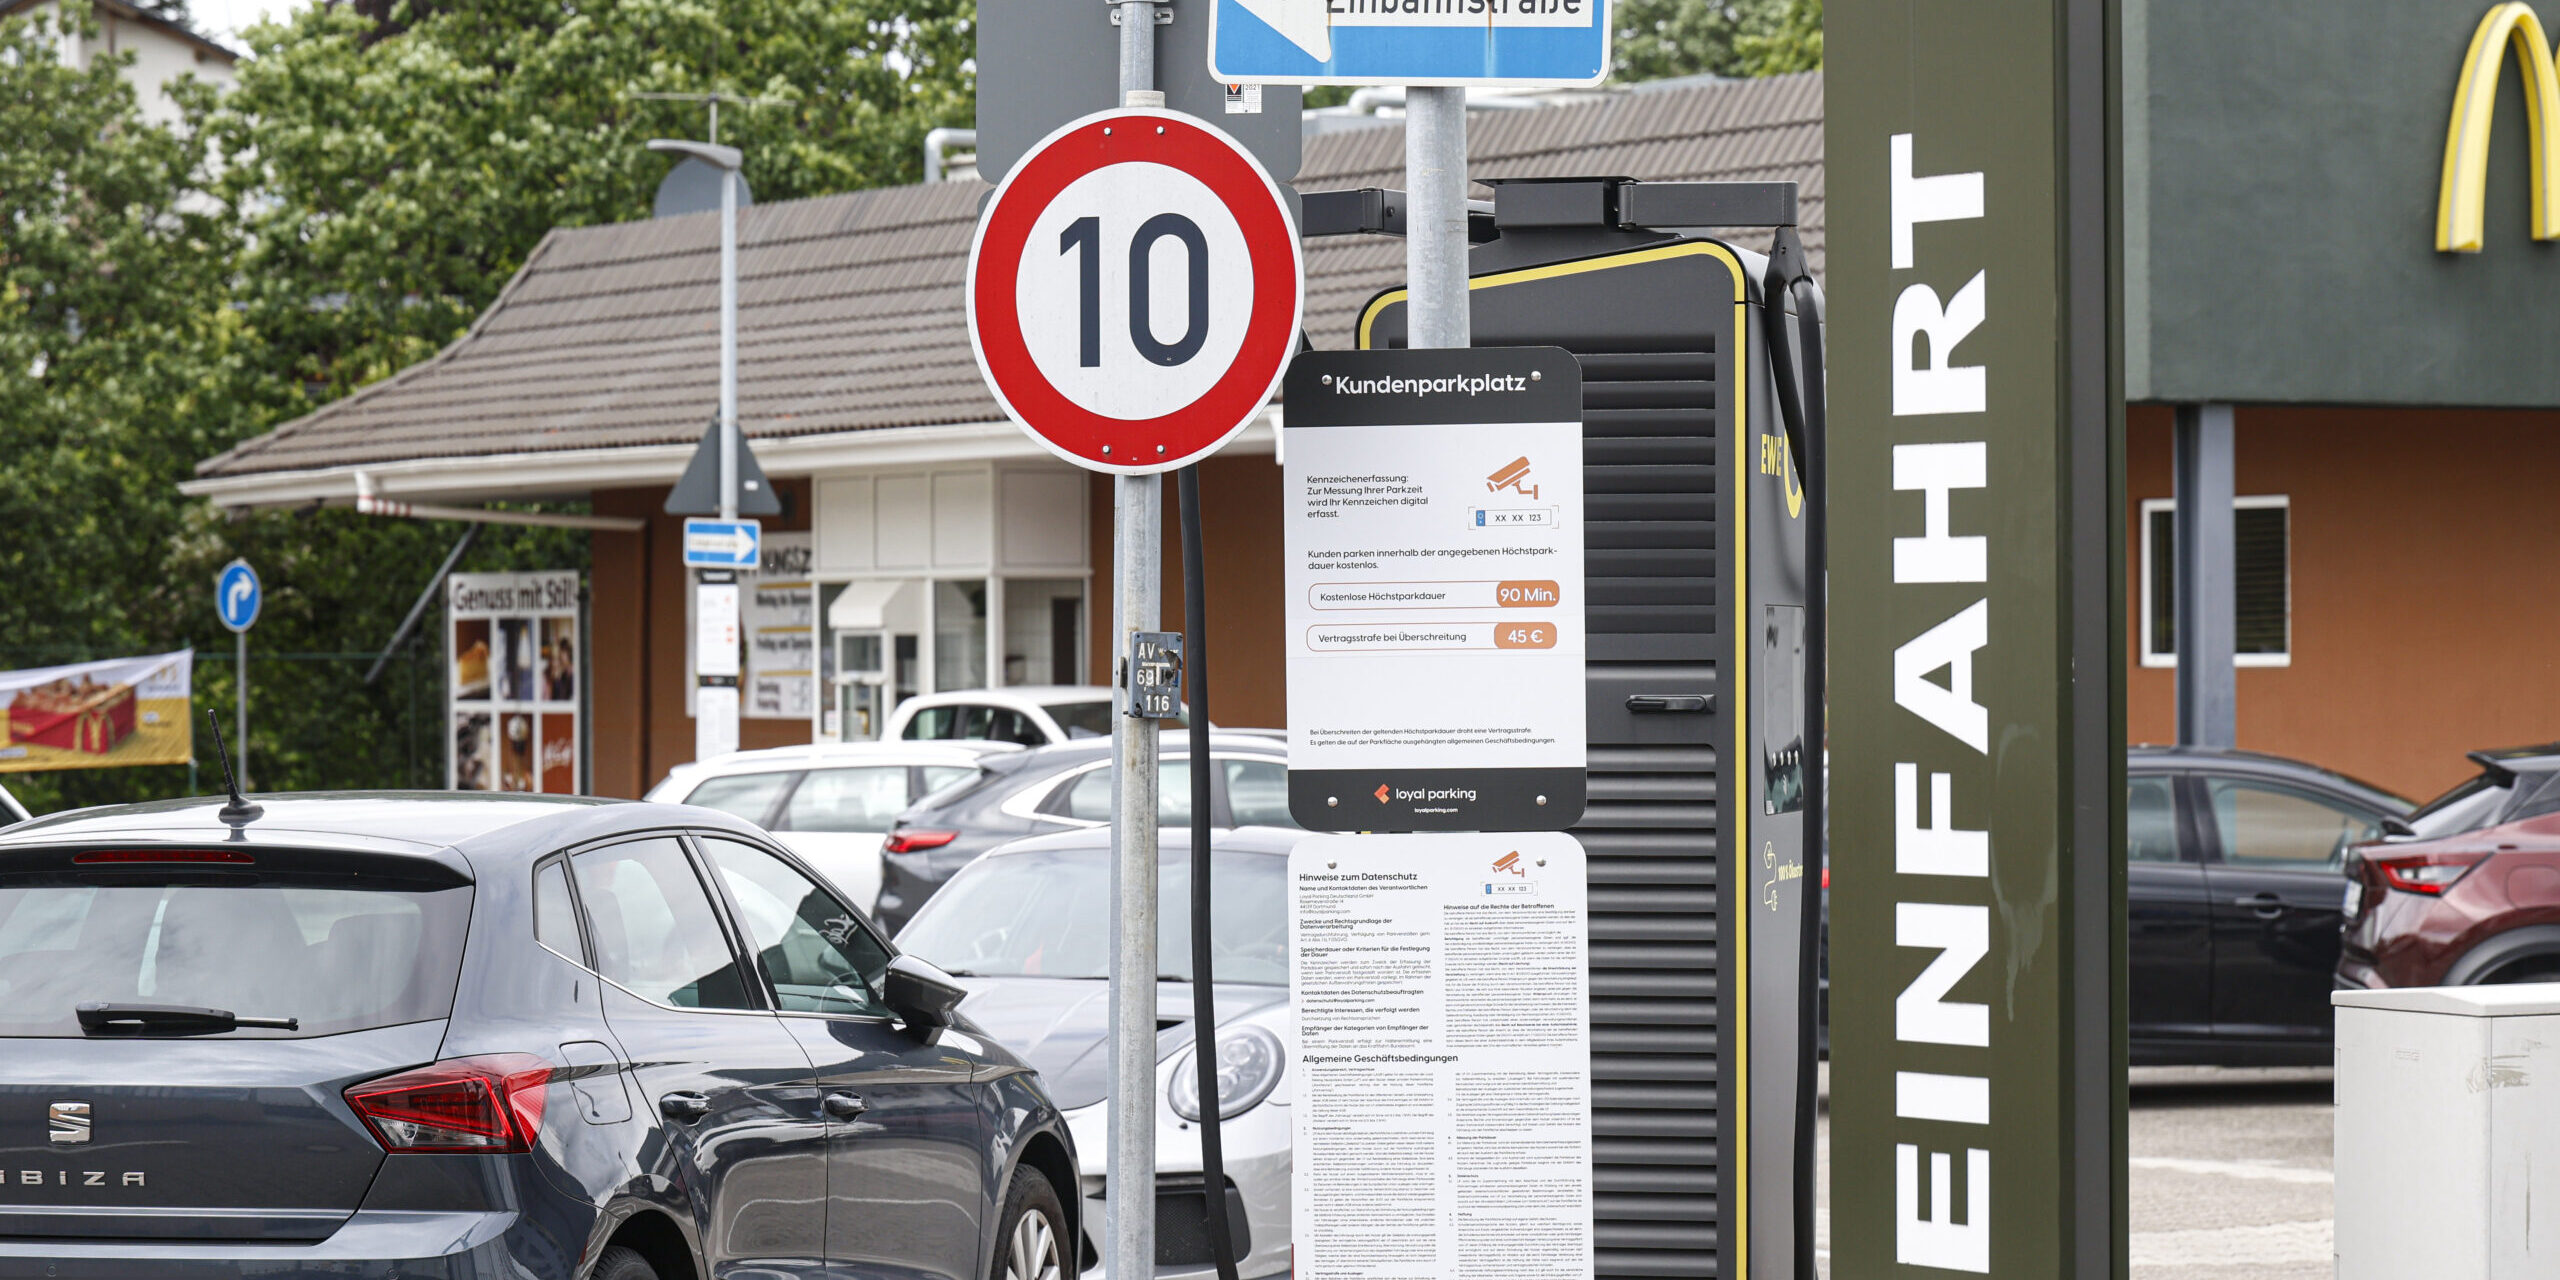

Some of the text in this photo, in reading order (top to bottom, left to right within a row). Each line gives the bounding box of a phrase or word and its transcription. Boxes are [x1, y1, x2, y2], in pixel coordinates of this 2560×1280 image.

[1060, 212, 1208, 368] 10
[1336, 375, 1526, 396] Kundenparkplatz
[1761, 433, 1782, 477] EWE
[1307, 475, 1408, 483] Kennzeichenerfassung:
[1307, 487, 1321, 495] Zur
[1323, 486, 1362, 496] Messung
[1400, 497, 1428, 506] digital
[1307, 510, 1339, 518] erfasst.
[1308, 547, 1557, 559] Kunden parken innerhalb der angegebenen Höchstpark-
[1308, 561, 1378, 570] dauer kostenlos.
[456, 582, 512, 610] Genuss
[516, 578, 542, 609] mit
[1320, 588, 1556, 603] Kostenlose Höchstparkdauer 90 Min.
[1319, 629, 1543, 645] Vertragsstrafe bei Überschreitung 45 €
[1138, 643, 1155, 659] AV
[1890, 133, 1990, 1274] EINFAHRT
[1396, 788, 1476, 801] loyal parking
[1302, 1054, 1458, 1064] Allgemeine Geschäftsbedingungen
